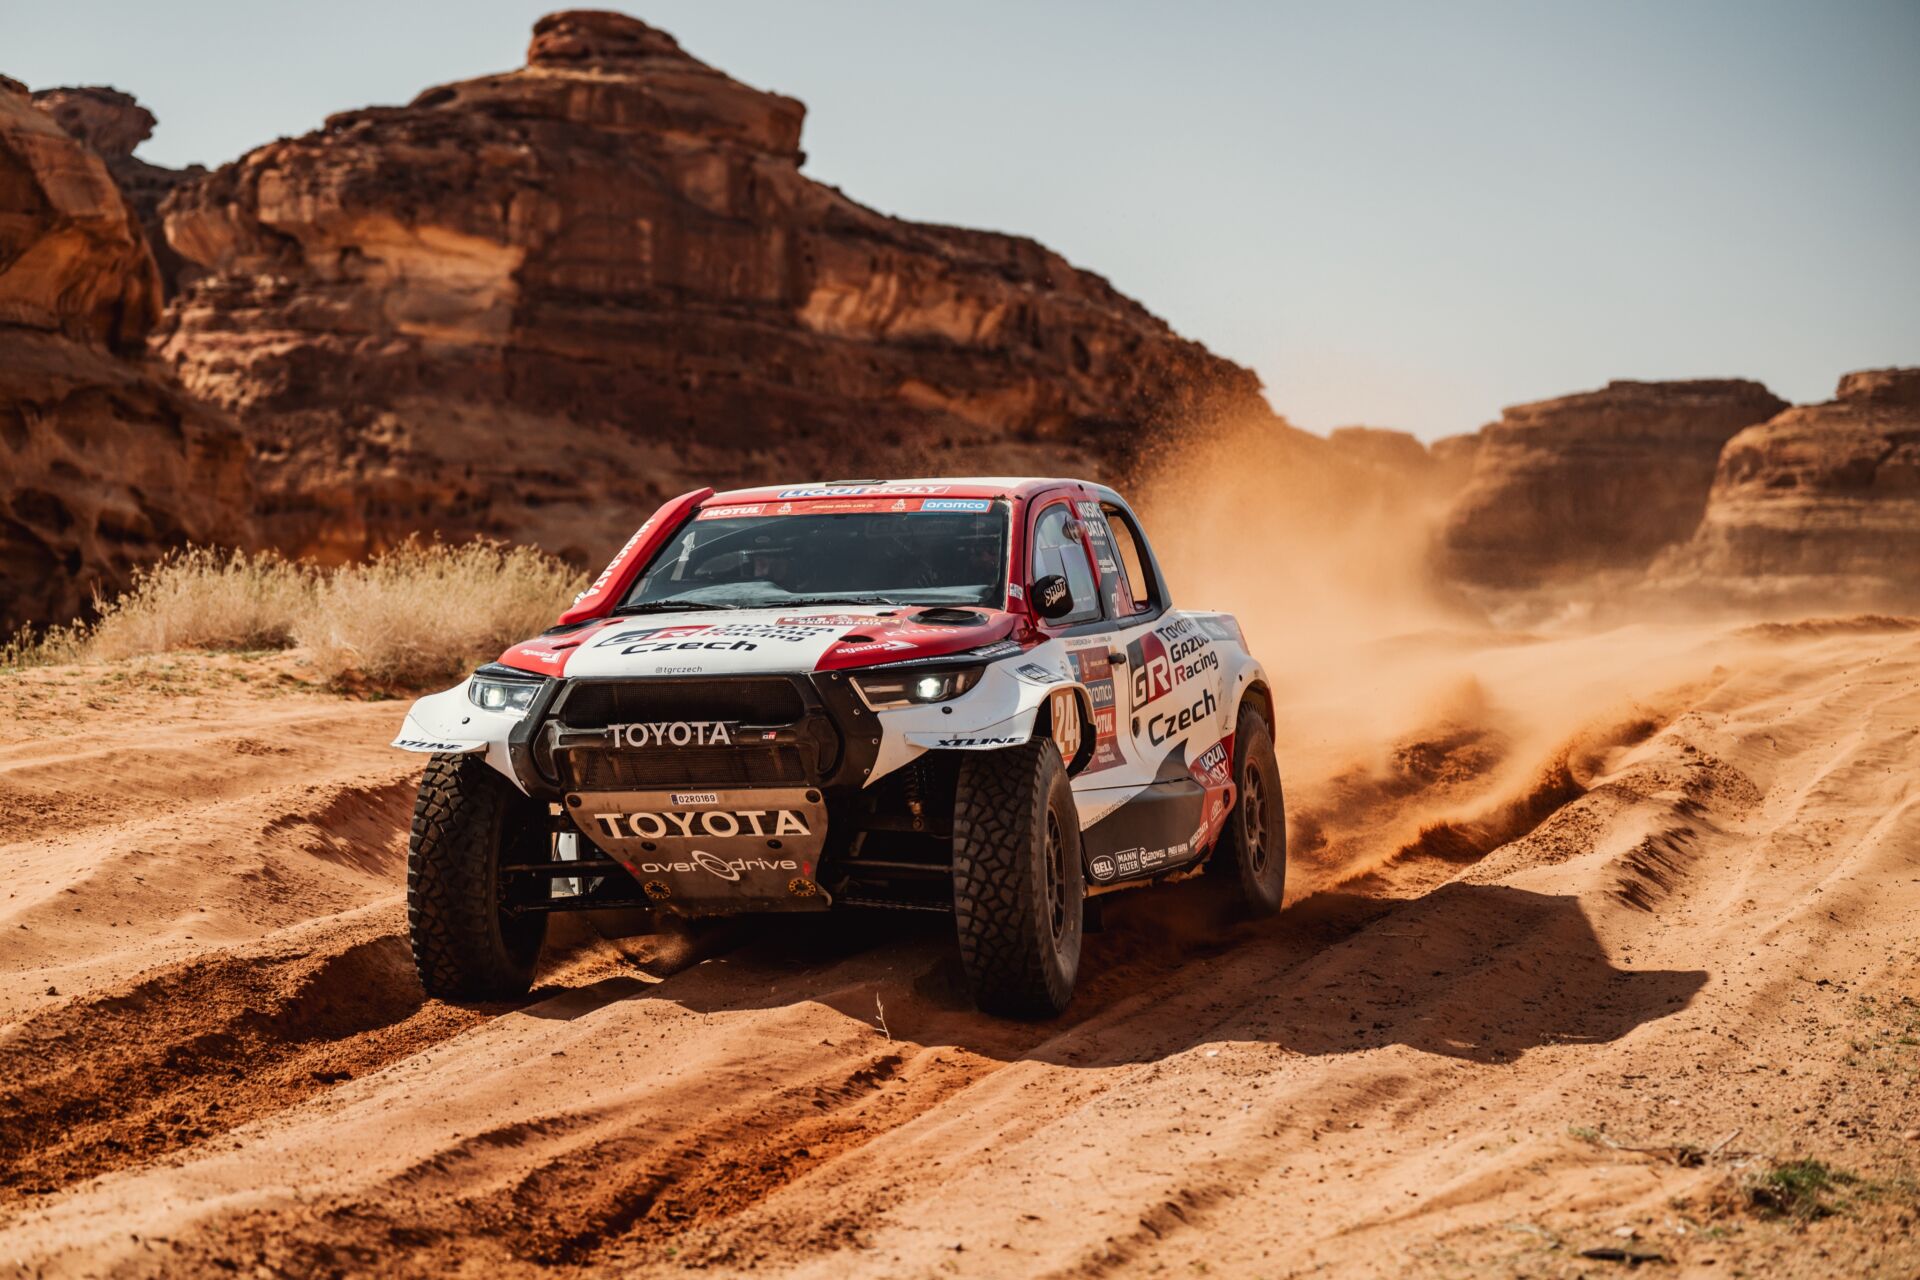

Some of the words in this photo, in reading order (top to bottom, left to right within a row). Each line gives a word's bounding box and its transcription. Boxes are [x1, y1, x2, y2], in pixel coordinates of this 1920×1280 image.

[781, 487, 863, 498] LIQUI
[863, 485, 946, 495] MOLY
[703, 505, 761, 517] MOTUL
[926, 501, 986, 510] aramco
[1084, 521, 1106, 538] DATA
[1043, 580, 1067, 602] SHOT
[701, 630, 806, 642] Racing
[725, 624, 835, 633] TOYOTA
[1155, 618, 1194, 642] TOYOTA
[620, 640, 758, 655] Czech
[836, 641, 892, 655] agados
[1174, 651, 1219, 686] Racing
[1131, 655, 1171, 708] GR
[1096, 713, 1113, 734] OTUL
[1148, 689, 1217, 747] Czech
[607, 721, 731, 748] TOYOTA
[937, 736, 1024, 747] XTLINE
[594, 810, 812, 839] TOYOTA
[1117, 851, 1137, 864] MANN
[1092, 860, 1114, 874] BELL
[1119, 861, 1139, 873] FILTER
